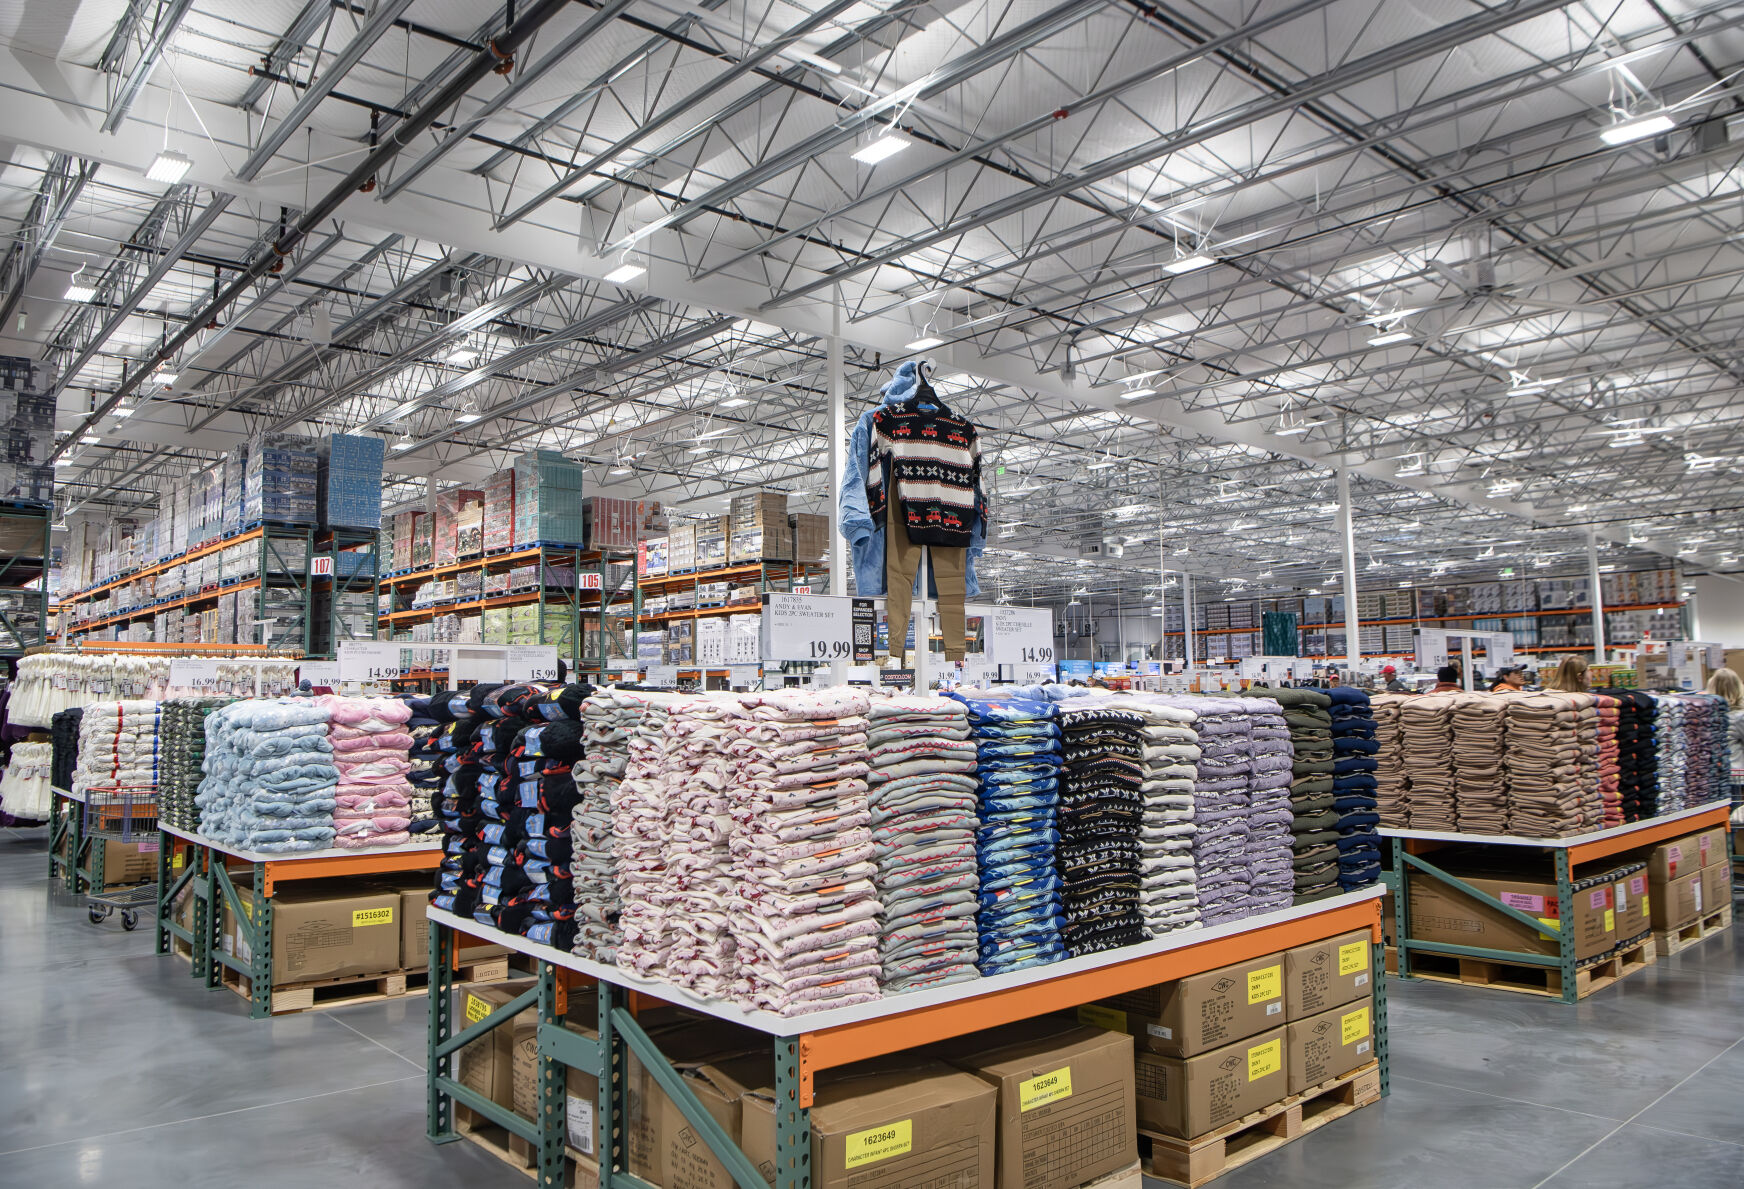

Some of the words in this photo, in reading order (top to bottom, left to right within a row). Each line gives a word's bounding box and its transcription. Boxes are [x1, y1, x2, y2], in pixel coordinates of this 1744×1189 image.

[315, 559, 330, 573] 107
[582, 575, 598, 587] 105
[809, 640, 851, 658] 19.99
[1021, 647, 1053, 663] 14.99
[368, 667, 398, 678] 14.99
[531, 669, 556, 679] 15.99
[937, 672, 955, 680] 31.99
[982, 672, 998, 680] 19.99
[191, 677, 215, 686] 16.99
[319, 678, 341, 686] 19.99
[356, 910, 390, 920] #1516302
[1033, 1076, 1058, 1092] 1623649
[863, 1130, 896, 1147] 1623649
[847, 1152, 870, 1163] CHARACTER
